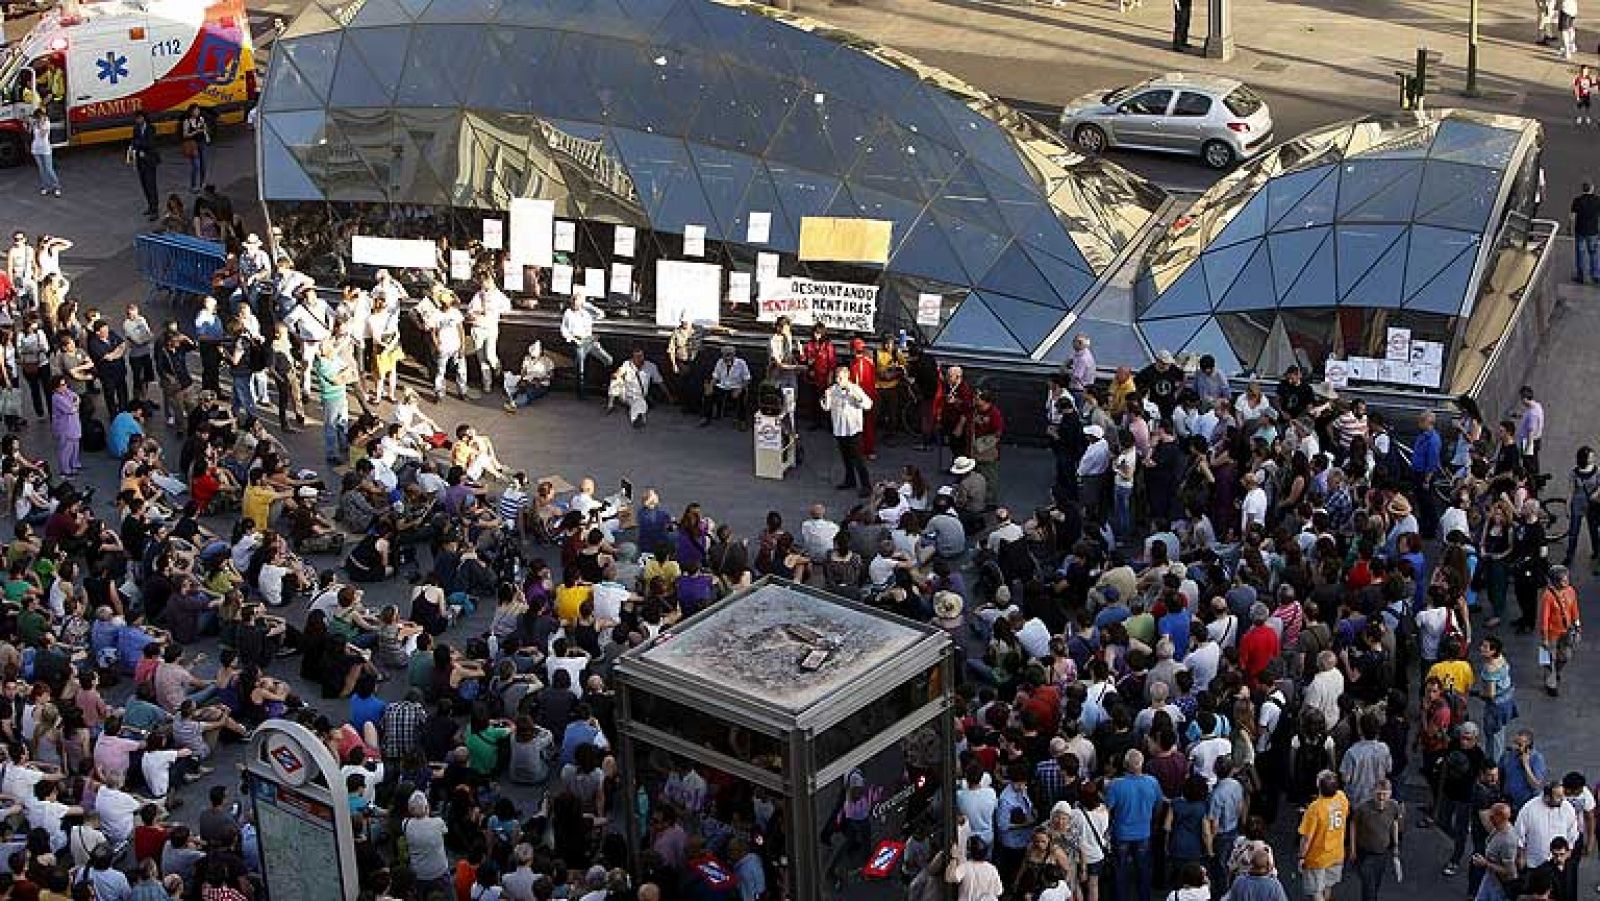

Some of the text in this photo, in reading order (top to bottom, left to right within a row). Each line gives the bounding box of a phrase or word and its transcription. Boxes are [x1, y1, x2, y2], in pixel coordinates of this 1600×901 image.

[158, 39, 182, 56] 112
[86, 98, 143, 118] SAMUR
[792, 281, 873, 300] DESMONTANDO
[763, 297, 808, 312] MENTIRAS
[812, 298, 872, 315] MENTIRAS
[1328, 810, 1343, 832] 16
